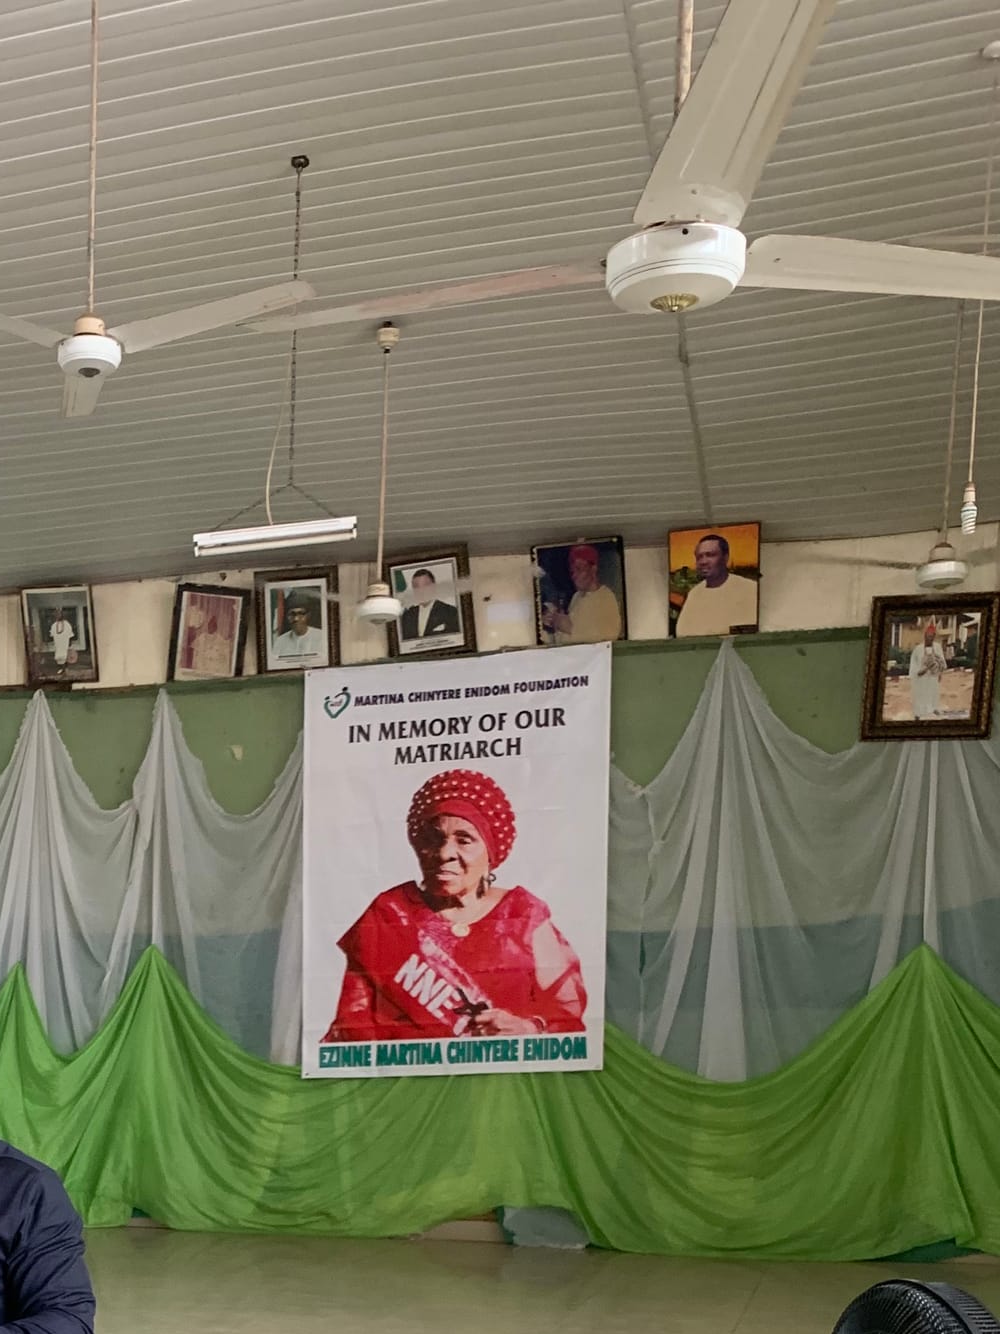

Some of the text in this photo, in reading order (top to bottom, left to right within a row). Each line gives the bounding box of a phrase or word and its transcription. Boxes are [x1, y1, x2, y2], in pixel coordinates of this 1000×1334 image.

[353, 692, 405, 707] MARTINA
[408, 688, 461, 703] CHINYERE
[464, 683, 510, 698] ENIDOM
[514, 675, 589, 693] FOUNDATION
[348, 707, 566, 743] IN MEMORY OF OUR
[394, 737, 522, 765] MATRIARCH
[319, 1036, 587, 1068] EZINNE MARTINA CHINYERE ENIDOM
